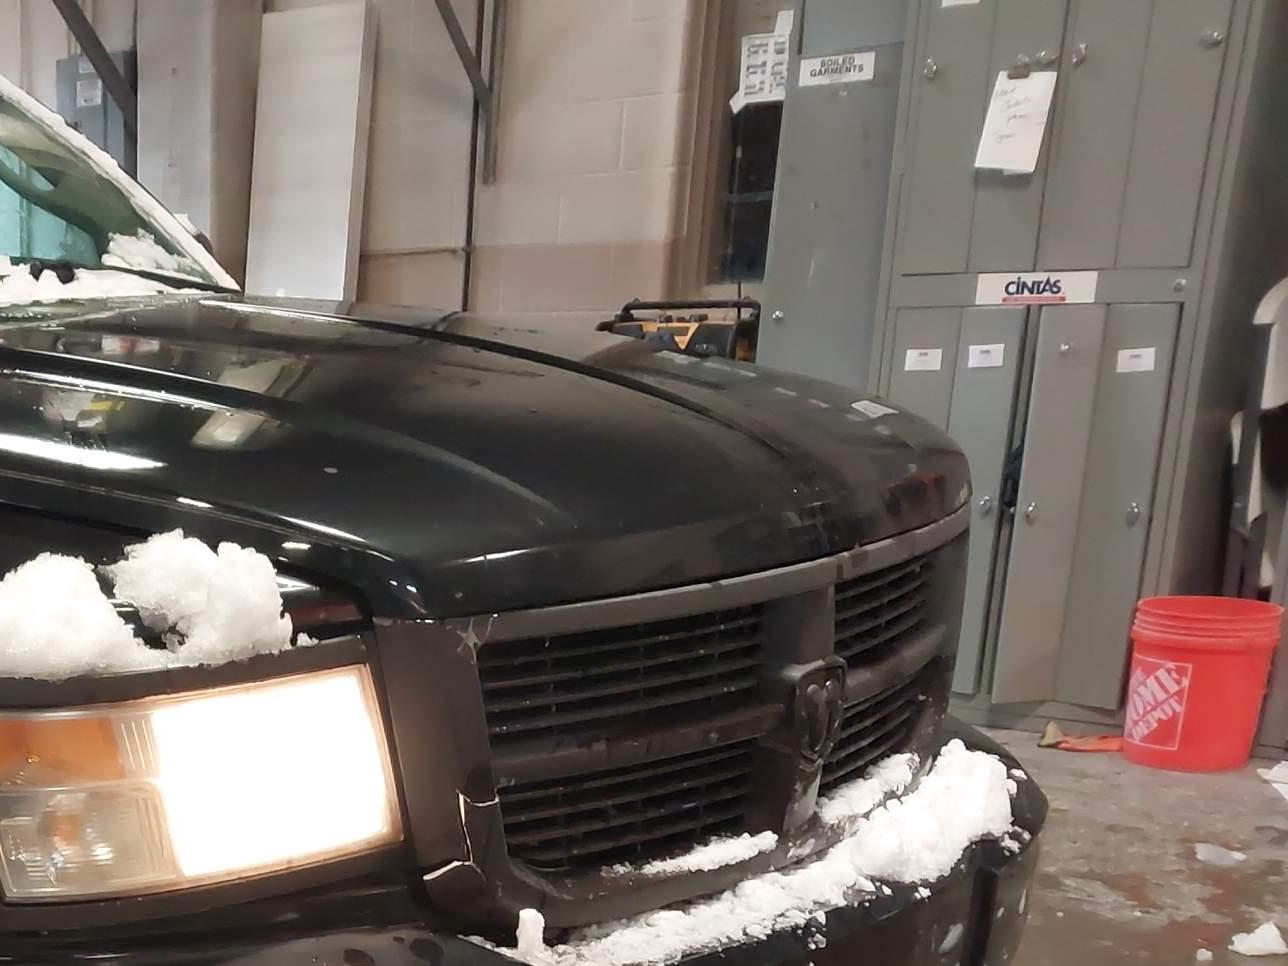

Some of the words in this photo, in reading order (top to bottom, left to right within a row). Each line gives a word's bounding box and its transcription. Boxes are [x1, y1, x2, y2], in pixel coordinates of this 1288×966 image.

[820, 56, 855, 68] SOILED
[810, 64, 864, 77] GARMENTS
[1004, 276, 1062, 296] CINTAS
